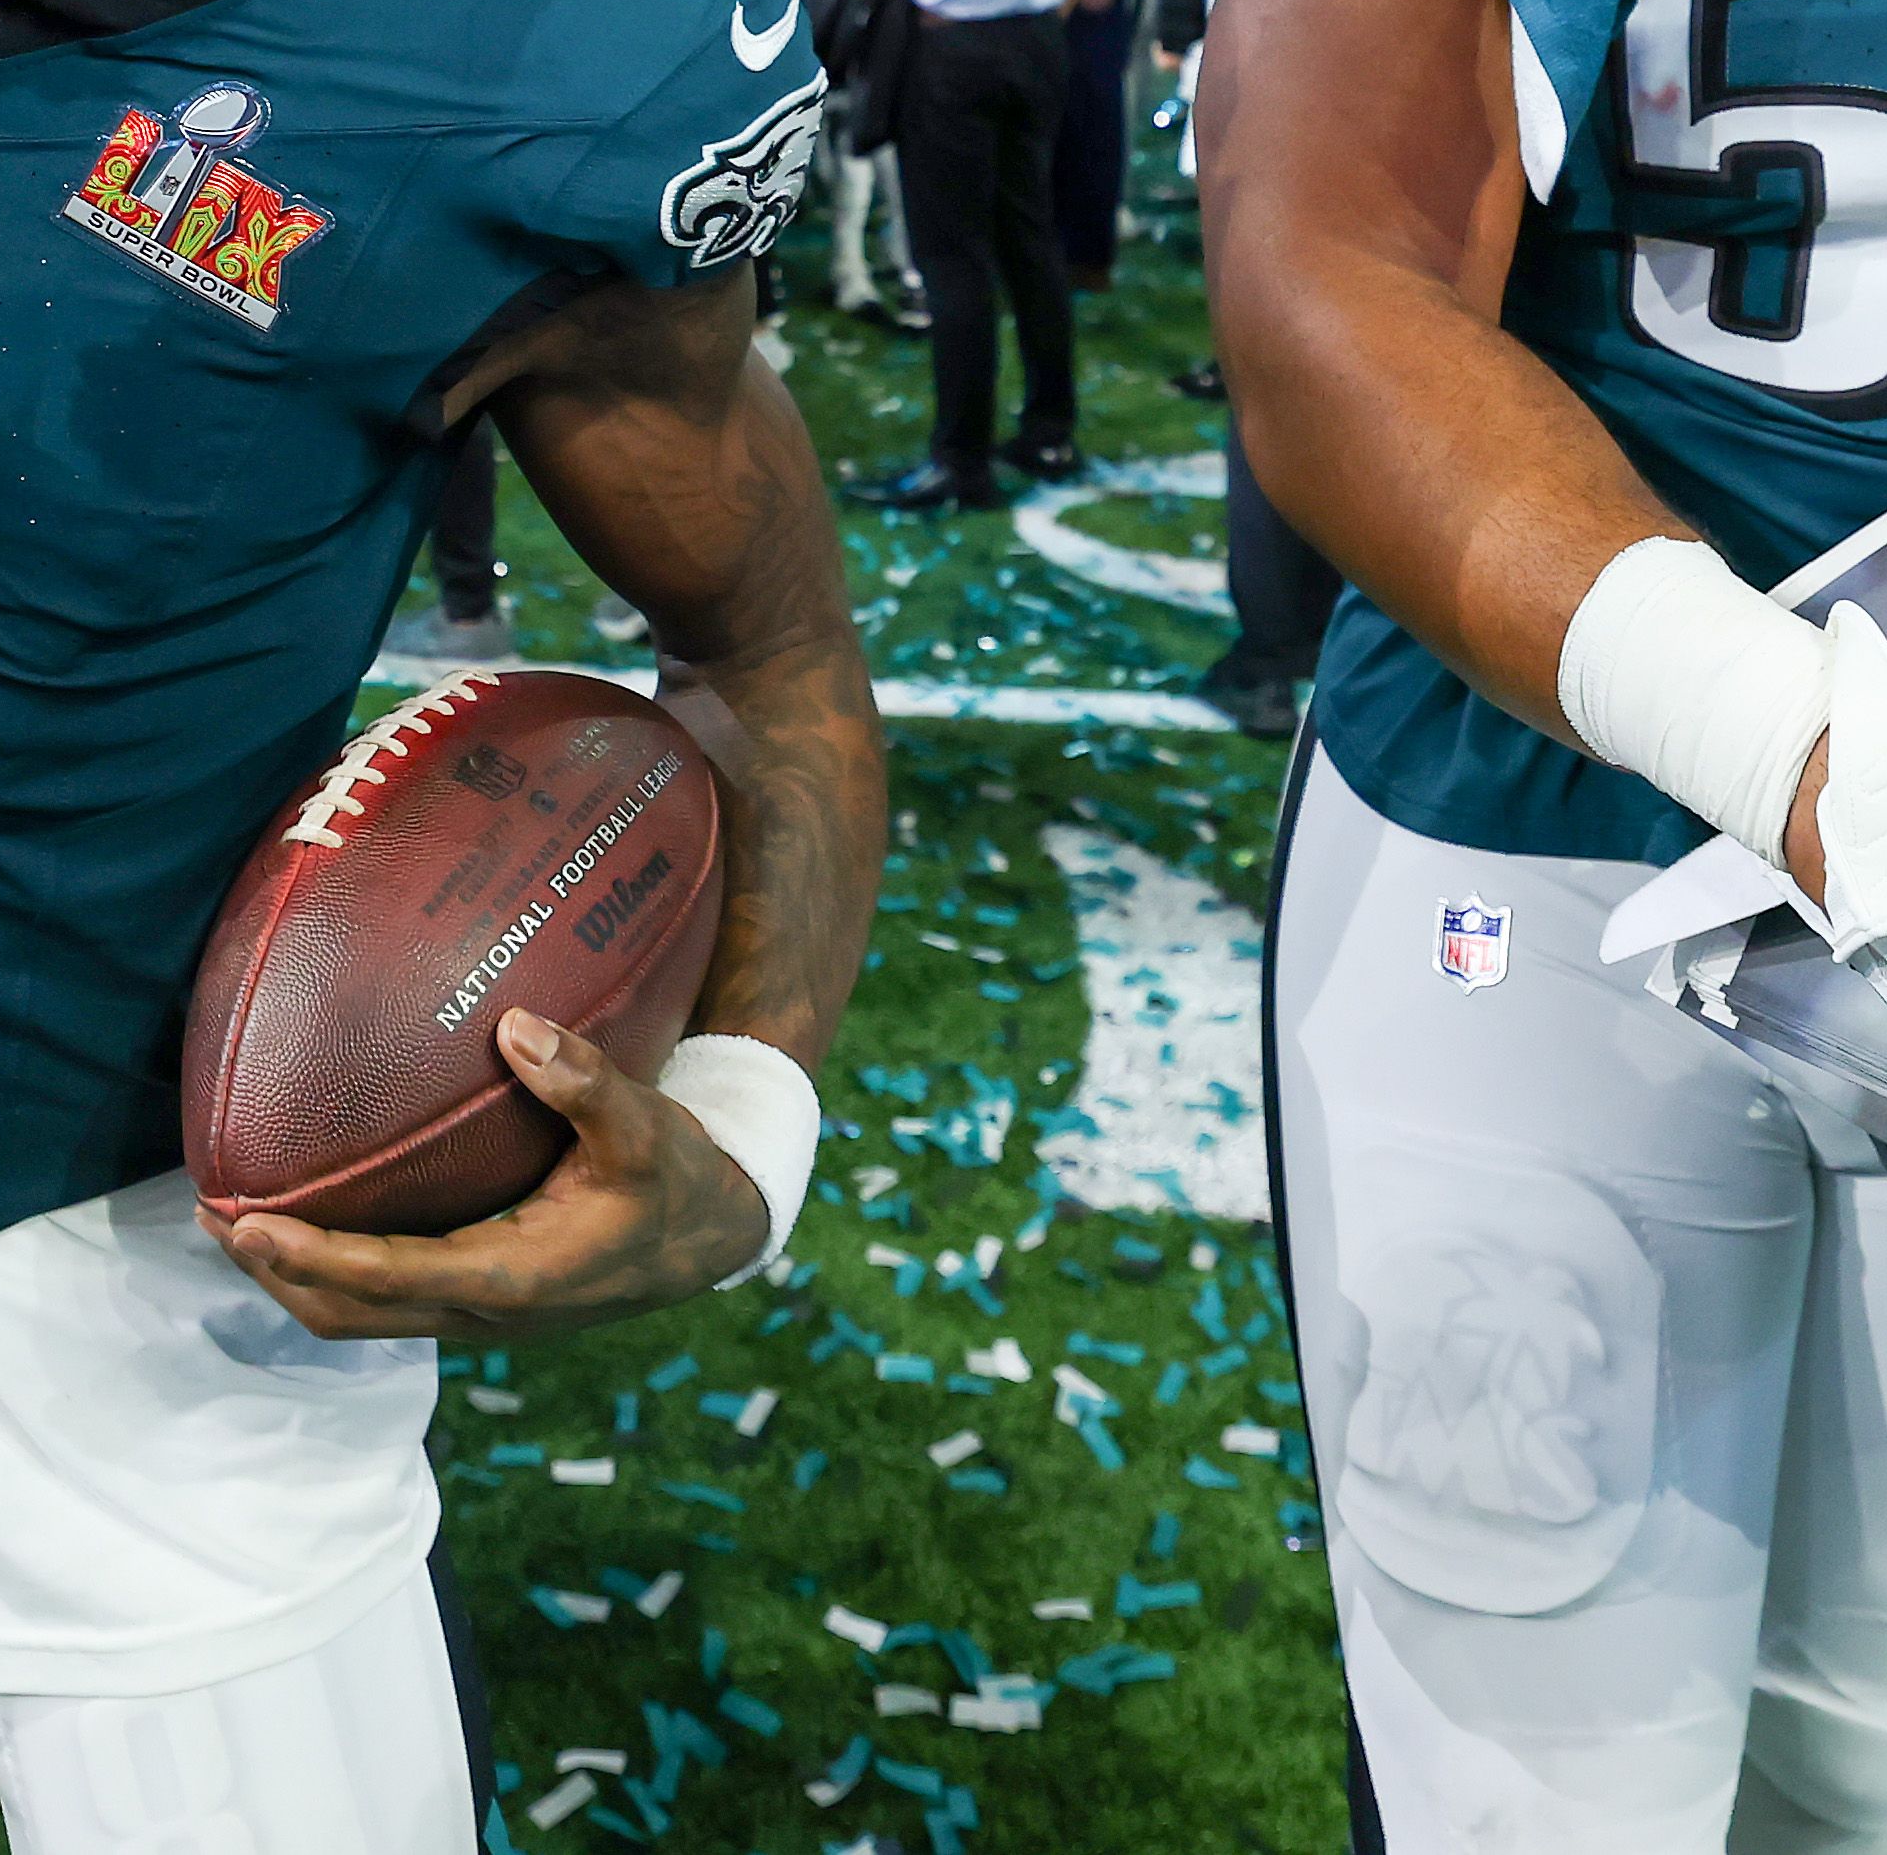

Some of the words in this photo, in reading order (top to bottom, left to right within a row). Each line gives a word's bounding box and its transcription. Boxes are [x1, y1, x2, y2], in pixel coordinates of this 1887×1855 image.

[87, 211, 176, 270] SUPER
[180, 267, 251, 315] BOWL
[435, 901, 554, 1033] NATIONAL
[548, 796, 645, 899] FOOTBALL
[637, 750, 684, 800] LEAGUE
[573, 849, 673, 953] Wilson
